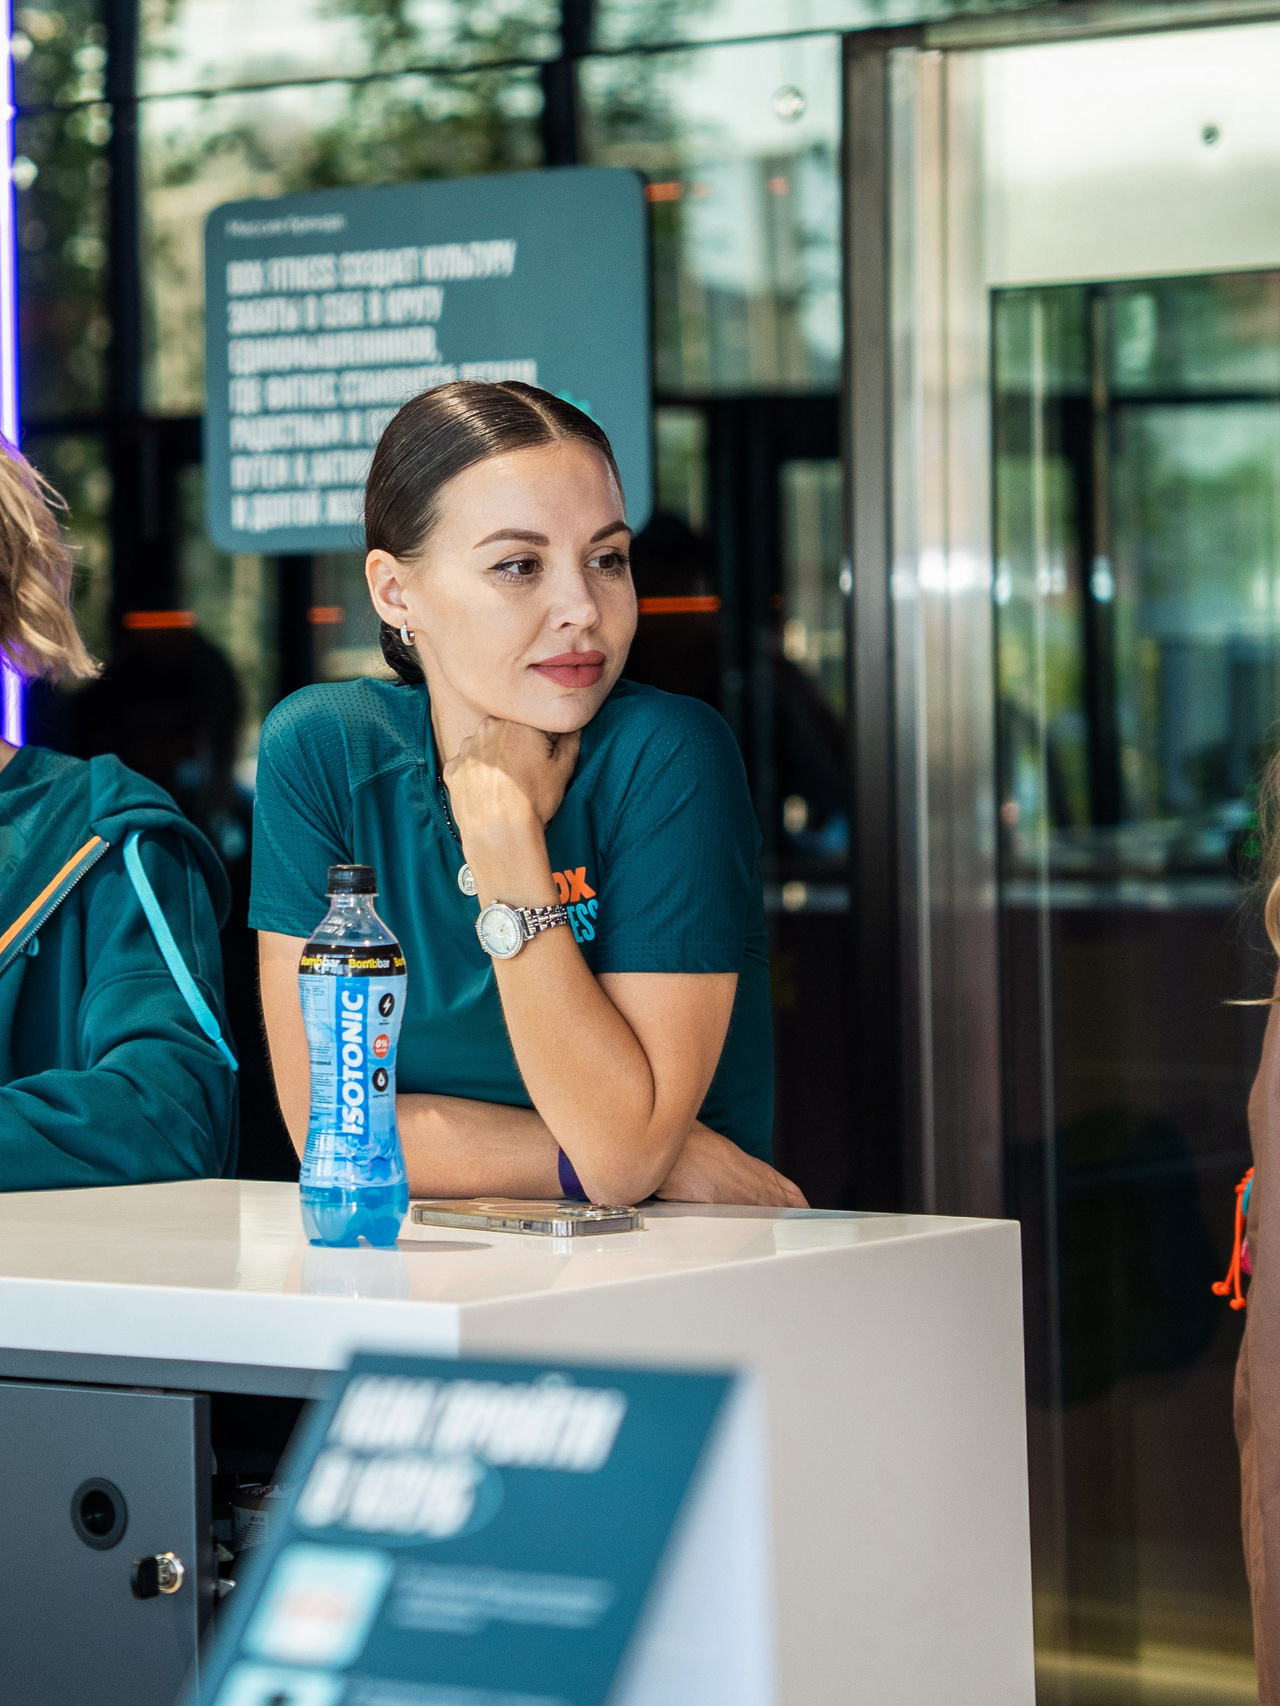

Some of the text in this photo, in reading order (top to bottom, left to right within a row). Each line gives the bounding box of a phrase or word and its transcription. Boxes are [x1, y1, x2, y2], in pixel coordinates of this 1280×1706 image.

[267, 253, 336, 293] FITNESS
[552, 866, 596, 904] DX
[348, 958, 390, 969] Bombbar
[375, 1038, 388, 1048] 0%
[341, 990, 365, 1135] ISOTONIC
